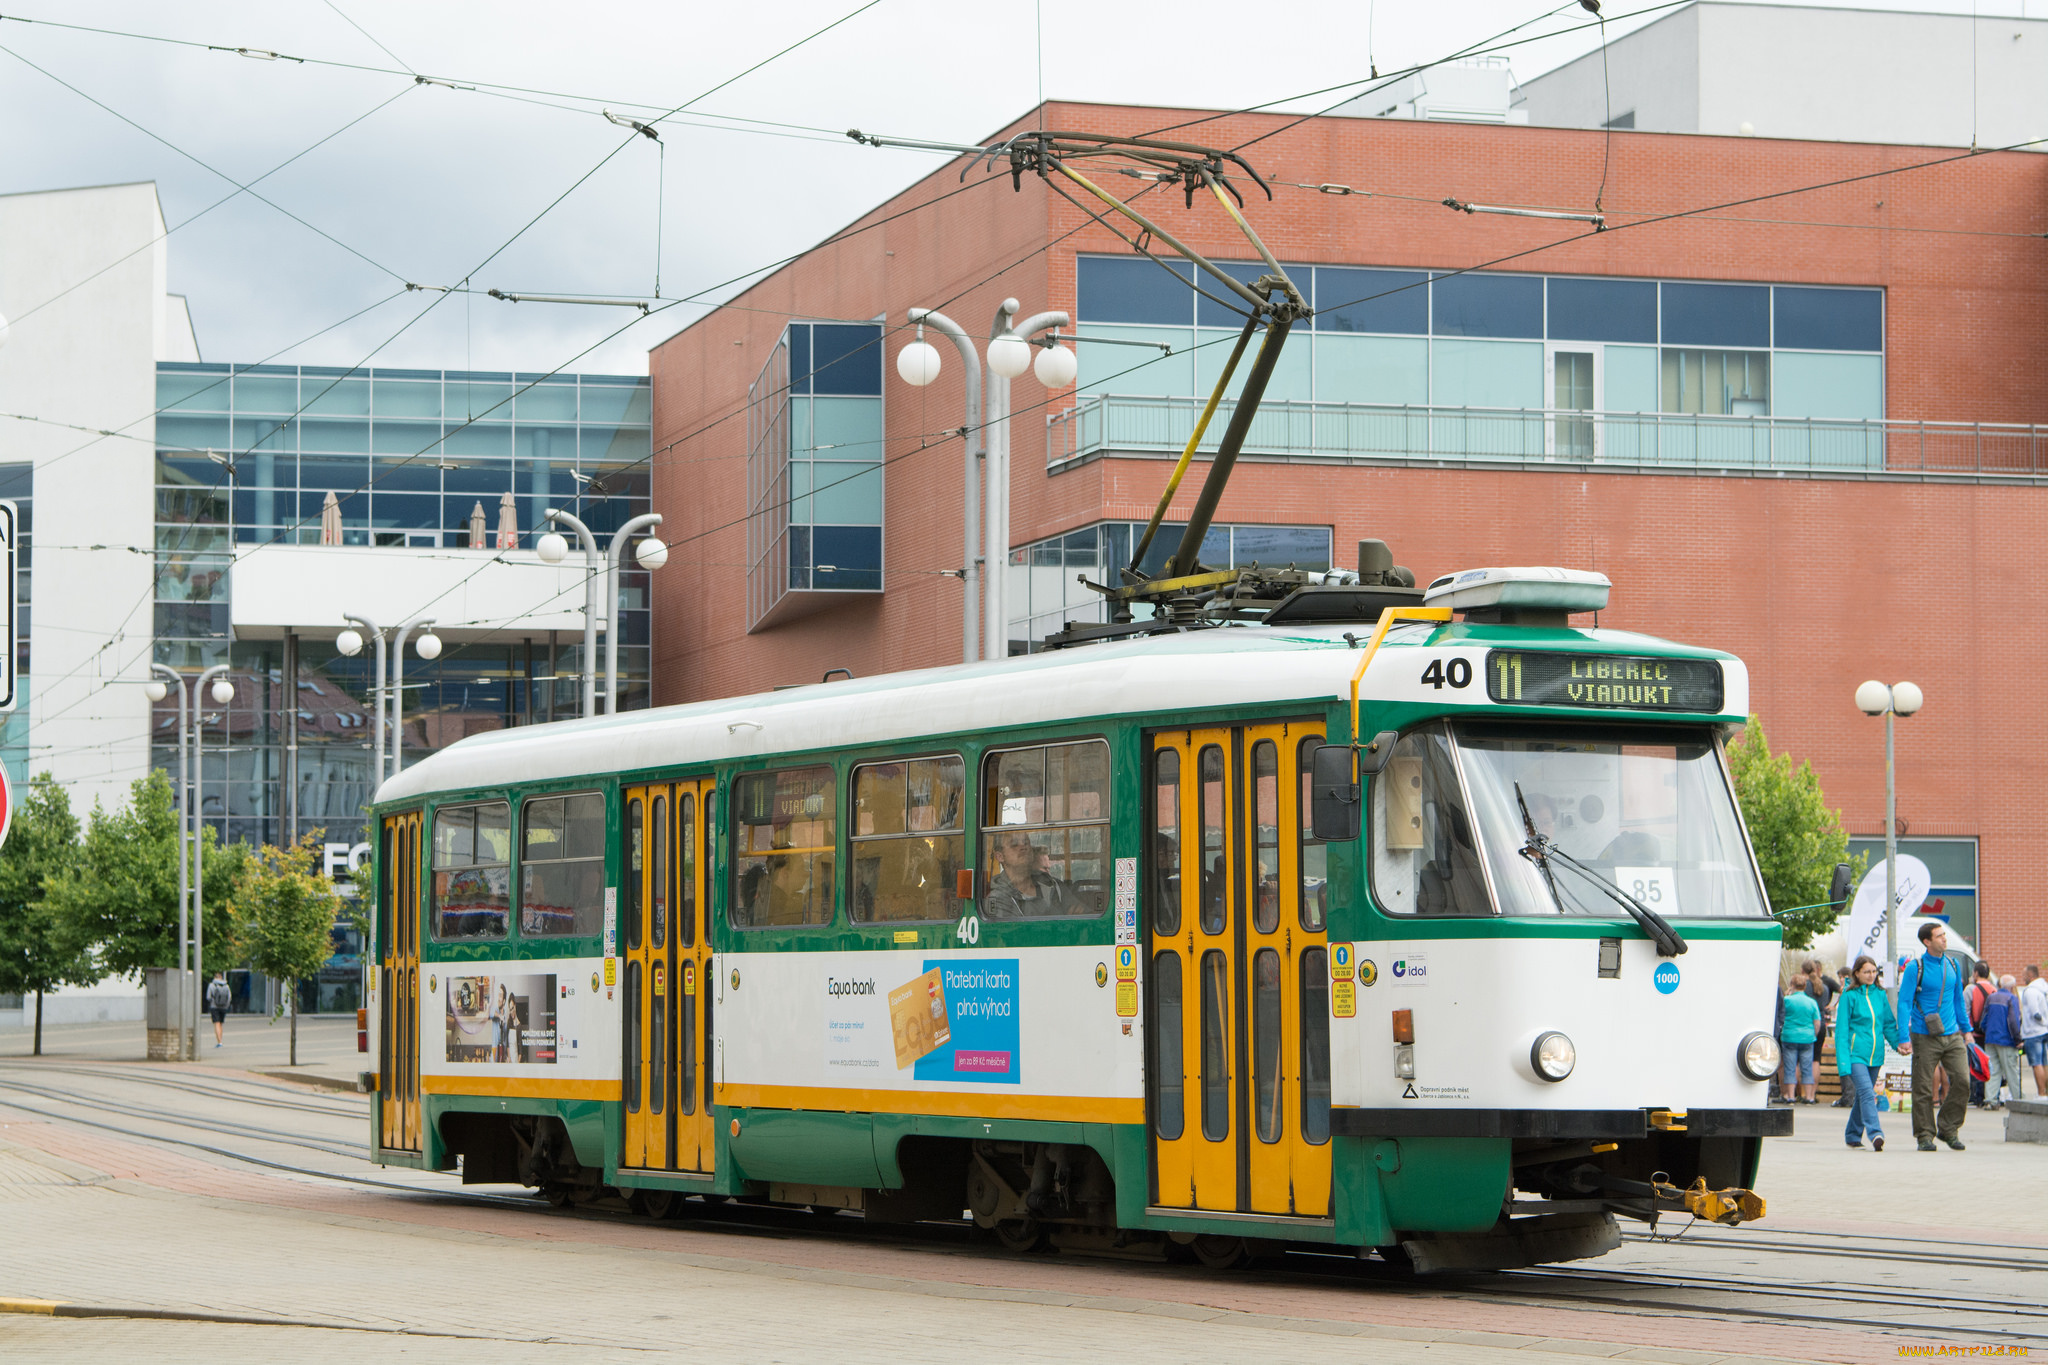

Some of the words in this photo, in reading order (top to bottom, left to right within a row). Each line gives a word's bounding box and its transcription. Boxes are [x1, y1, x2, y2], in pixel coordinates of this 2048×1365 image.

[1421, 657, 1473, 690] 40
[1496, 653, 1523, 700] 11
[1571, 660, 1669, 681] LIBEREC
[1568, 683, 1673, 704] VIADUKT
[753, 780, 765, 817] 11
[781, 797, 826, 815] VIADUKT
[1633, 879, 1662, 903] 85
[957, 916, 979, 944] 40
[946, 969, 984, 989] Platební
[985, 970, 1010, 989] karta
[1408, 966, 1427, 977] idol
[1656, 973, 1679, 983] 1000
[828, 977, 851, 999] Equa
[852, 977, 875, 995] bank
[957, 998, 978, 1020] plná
[982, 997, 1010, 1020] výhod
